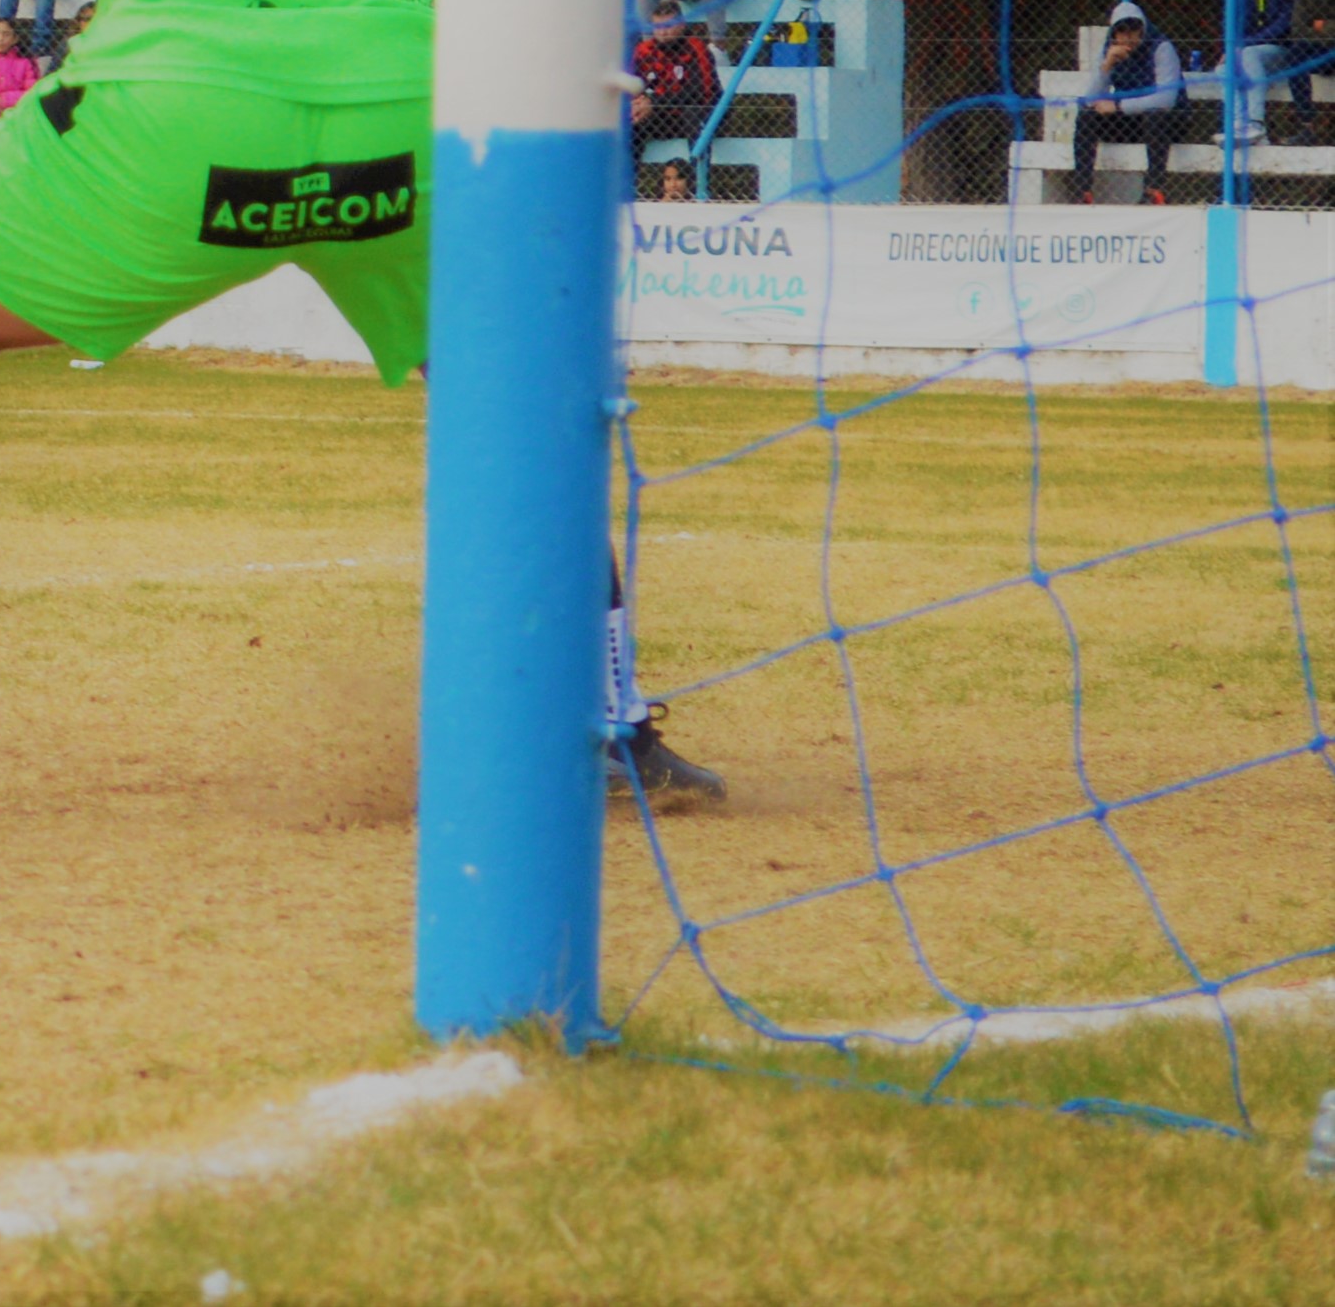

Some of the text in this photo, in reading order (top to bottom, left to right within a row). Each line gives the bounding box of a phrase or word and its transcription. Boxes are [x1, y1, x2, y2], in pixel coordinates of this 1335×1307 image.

[211, 187, 410, 231] ACEICOM
[634, 215, 793, 257] VICUÑA
[888, 227, 1167, 264] DIRECCIÓN DE DEPORTES
